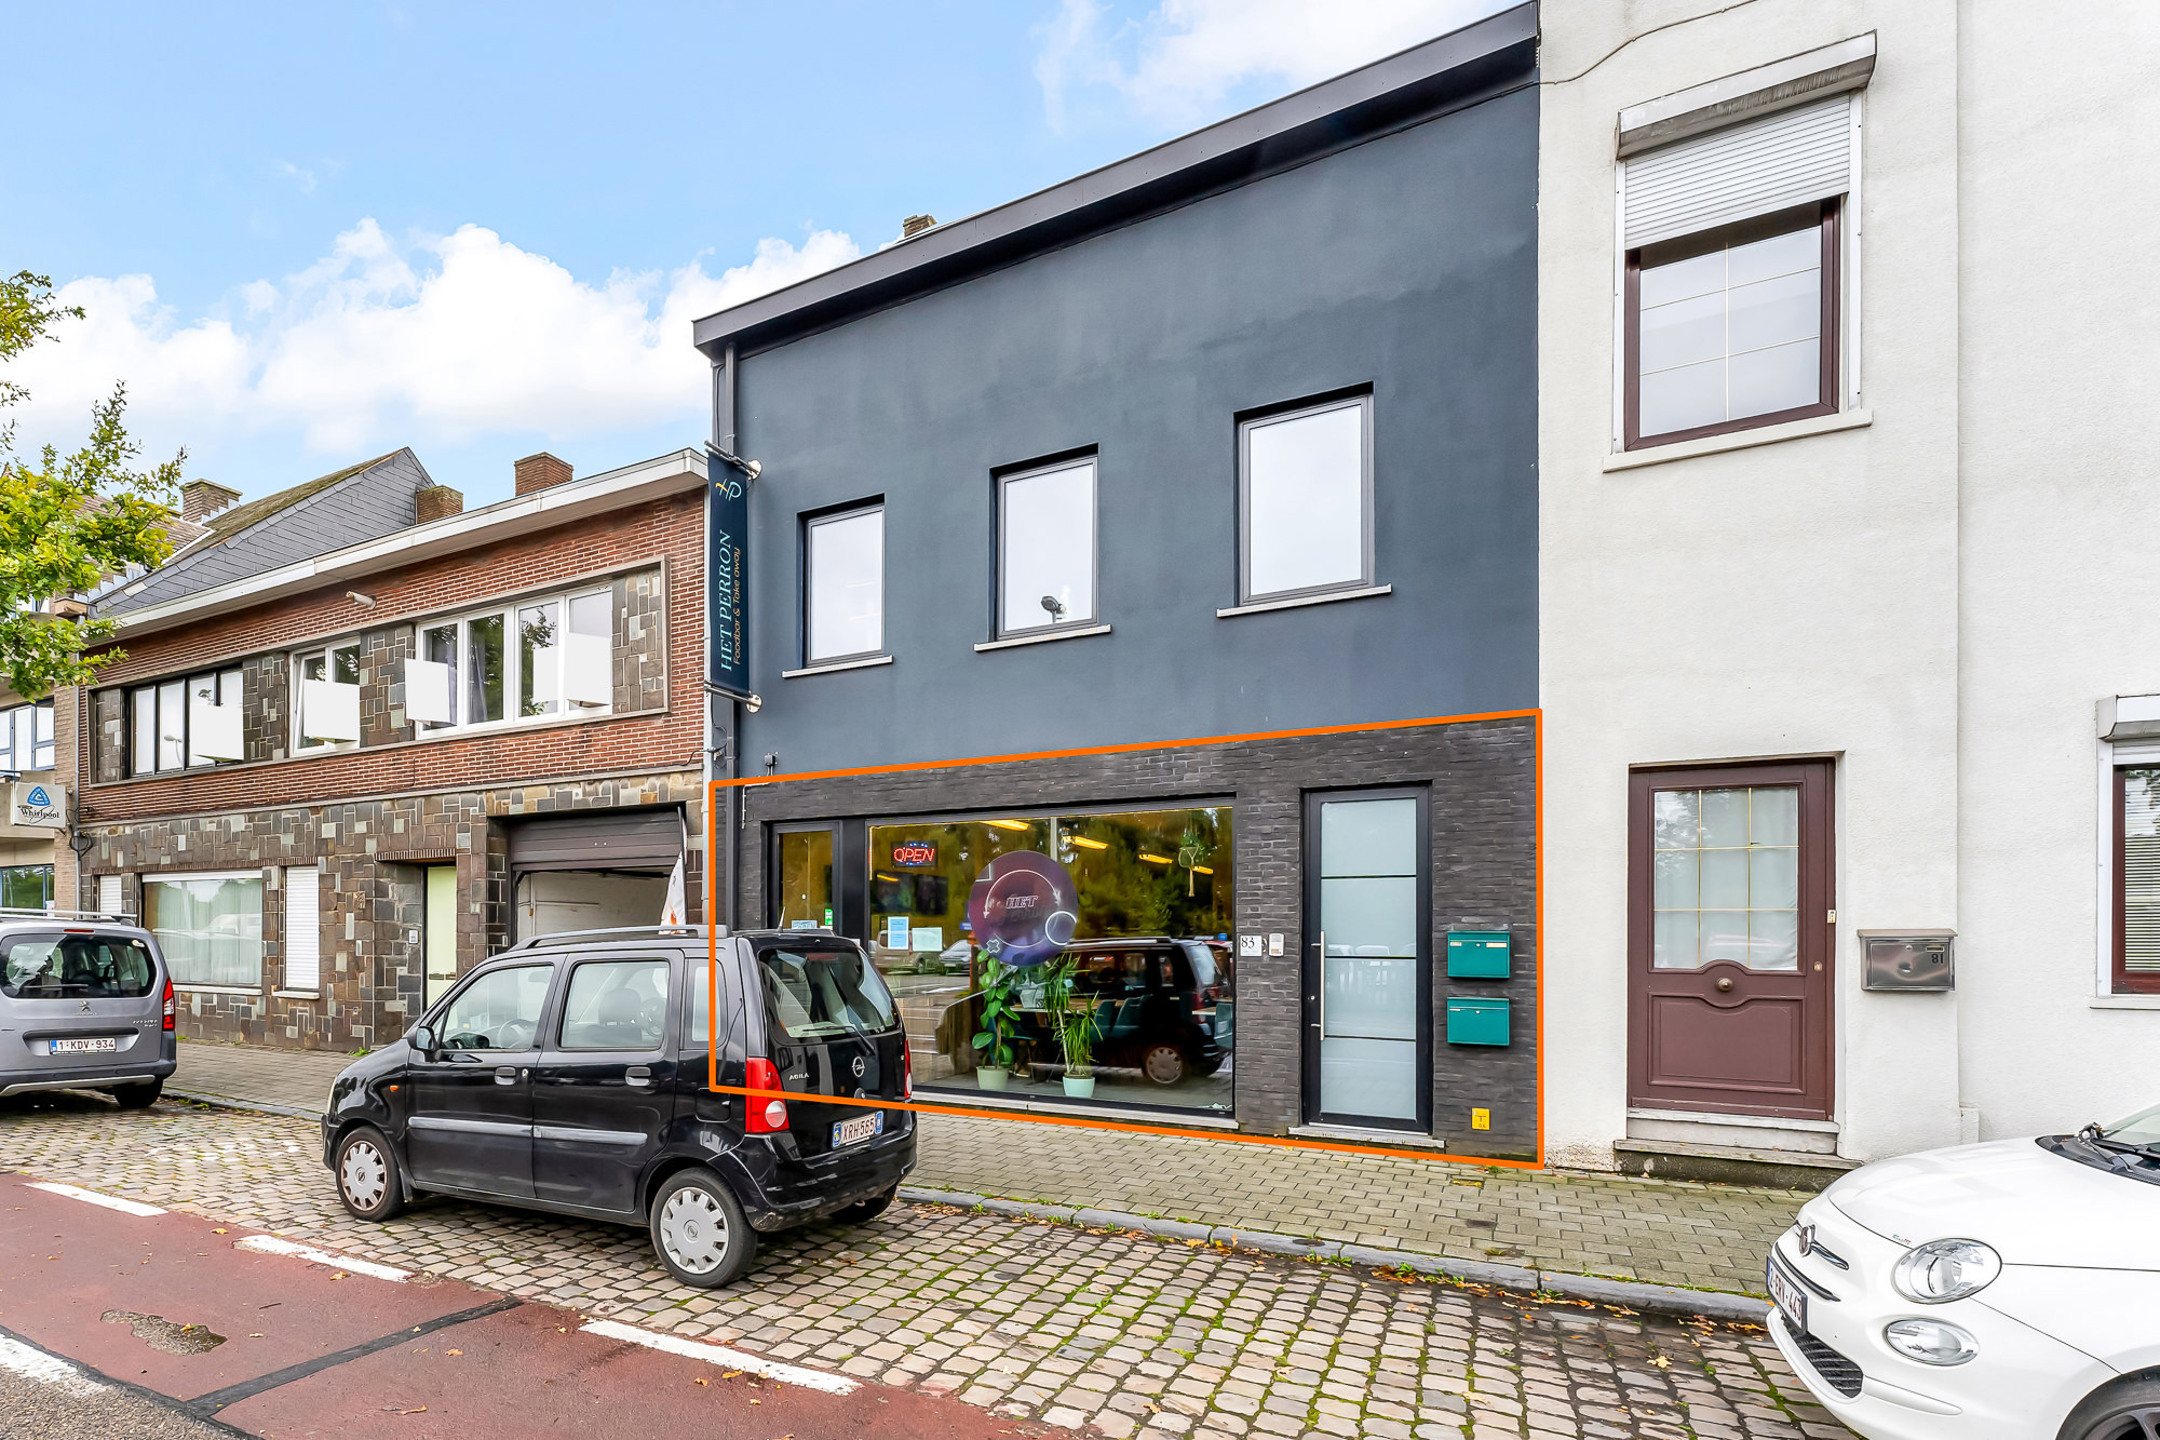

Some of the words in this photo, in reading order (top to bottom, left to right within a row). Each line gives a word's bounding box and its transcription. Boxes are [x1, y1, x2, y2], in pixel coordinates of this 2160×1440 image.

[733, 547, 741, 577] away
[719, 529, 731, 622] PERRON
[733, 580, 741, 604] Take
[733, 607, 741, 617] &
[720, 624, 732, 672] HET
[733, 618, 741, 665] Foodbar
[20, 807, 60, 820] Whirlpool
[893, 847, 935, 862] OPEN
[1006, 895, 1039, 909] HET
[1241, 936, 1255, 949] 83
[1931, 953, 1944, 964] 81
